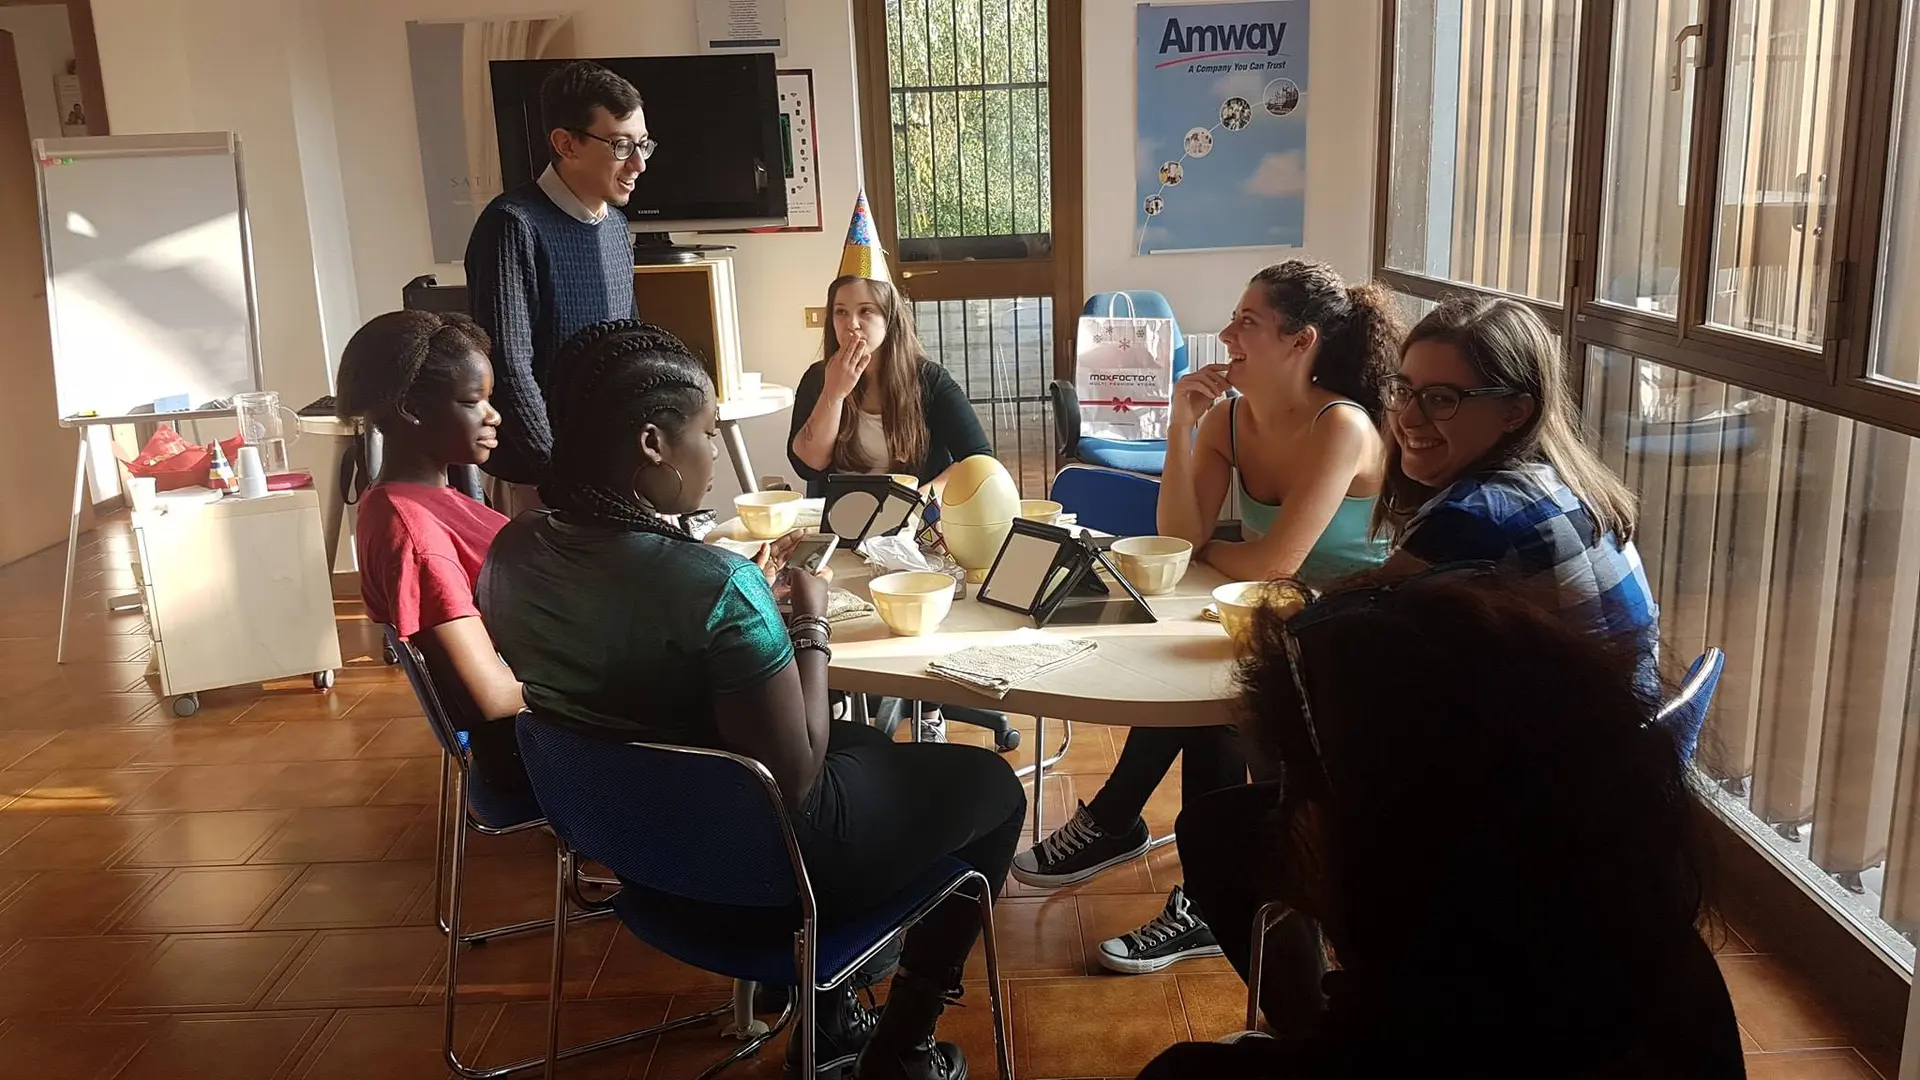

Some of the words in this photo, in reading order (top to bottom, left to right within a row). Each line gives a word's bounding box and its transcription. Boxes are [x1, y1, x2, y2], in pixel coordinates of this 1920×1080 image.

[1158, 17, 1287, 57] Amway
[1188, 66, 1194, 74] A
[1196, 63, 1232, 74] Company
[1234, 62, 1248, 71] You
[1249, 62, 1264, 71] Can
[1266, 61, 1287, 70] Trust
[450, 175, 502, 188] SATI
